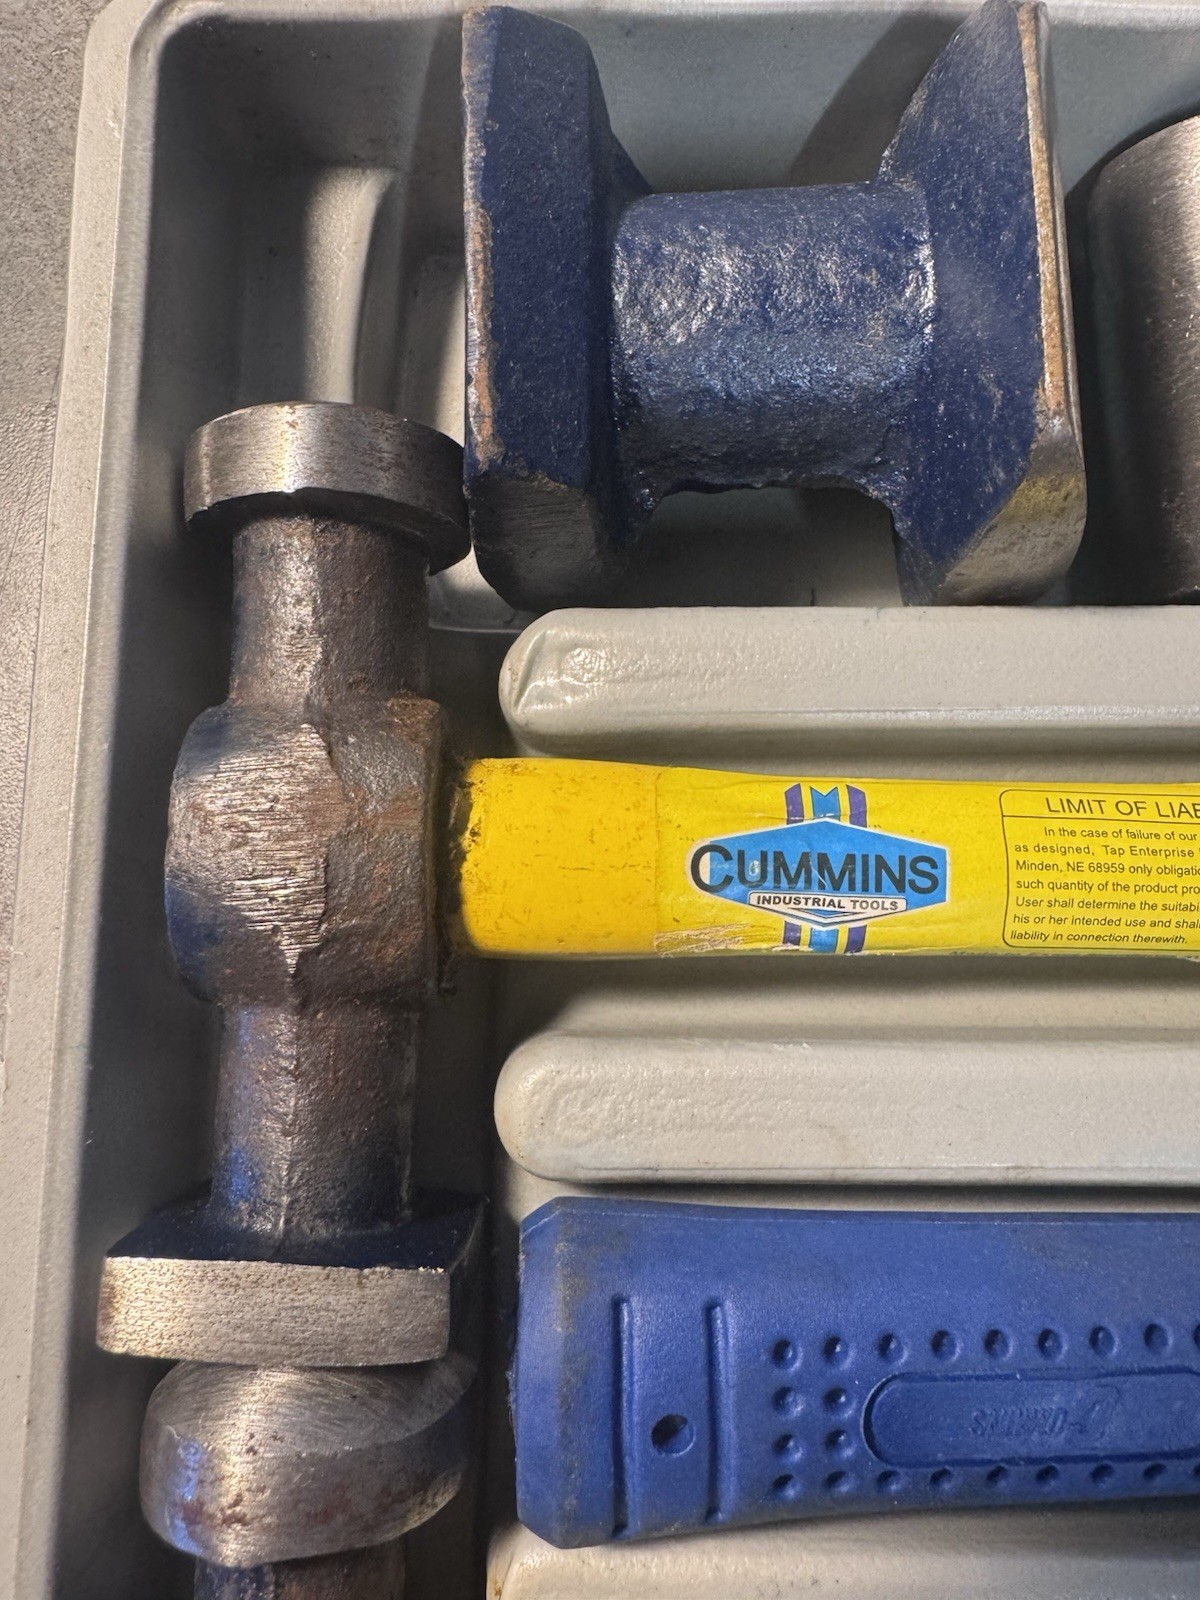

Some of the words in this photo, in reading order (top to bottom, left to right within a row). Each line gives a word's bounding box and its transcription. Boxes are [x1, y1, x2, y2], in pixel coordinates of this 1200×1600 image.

[1046, 798, 1106, 815] LIMIT
[1115, 800, 1147, 816] OF
[1045, 827, 1056, 837] In
[1059, 827, 1077, 838] the
[1081, 829, 1108, 838] case
[1112, 827, 1123, 839] of
[1126, 828, 1161, 840] failure
[1164, 830, 1176, 840] of
[1178, 833, 1197, 841] our
[1014, 844, 1029, 853] as
[1033, 843, 1095, 856] designed,
[1102, 844, 1125, 858] Tap
[1129, 845, 1195, 859] Enterprise
[690, 844, 940, 895] CUMMINS
[1016, 860, 1063, 873] Minden,
[1066, 862, 1085, 873] NE
[1088, 863, 1125, 874] 68959
[1128, 863, 1153, 877] only
[1016, 879, 1044, 890] such
[1047, 880, 1094, 893] quantity
[1097, 881, 1109, 893] of
[1111, 882, 1130, 893] the
[1133, 883, 1178, 896] product
[756, 894, 846, 909] INDUSTRIAL
[852, 900, 899, 911] TOOLS
[1016, 896, 1043, 907] User
[1046, 898, 1075, 909] shall
[1077, 899, 1136, 911] determine
[1139, 901, 1158, 911] the
[1013, 914, 1030, 924] his
[1033, 917, 1046, 925] or
[1048, 915, 1068, 925] her
[1071, 916, 1122, 928] intended
[1125, 919, 1146, 928] use
[1149, 919, 1172, 929] and
[1010, 930, 1050, 942] liability
[1052, 931, 1064, 941] in
[1066, 933, 1129, 944] connection
[1132, 934, 1188, 944] therewith.
